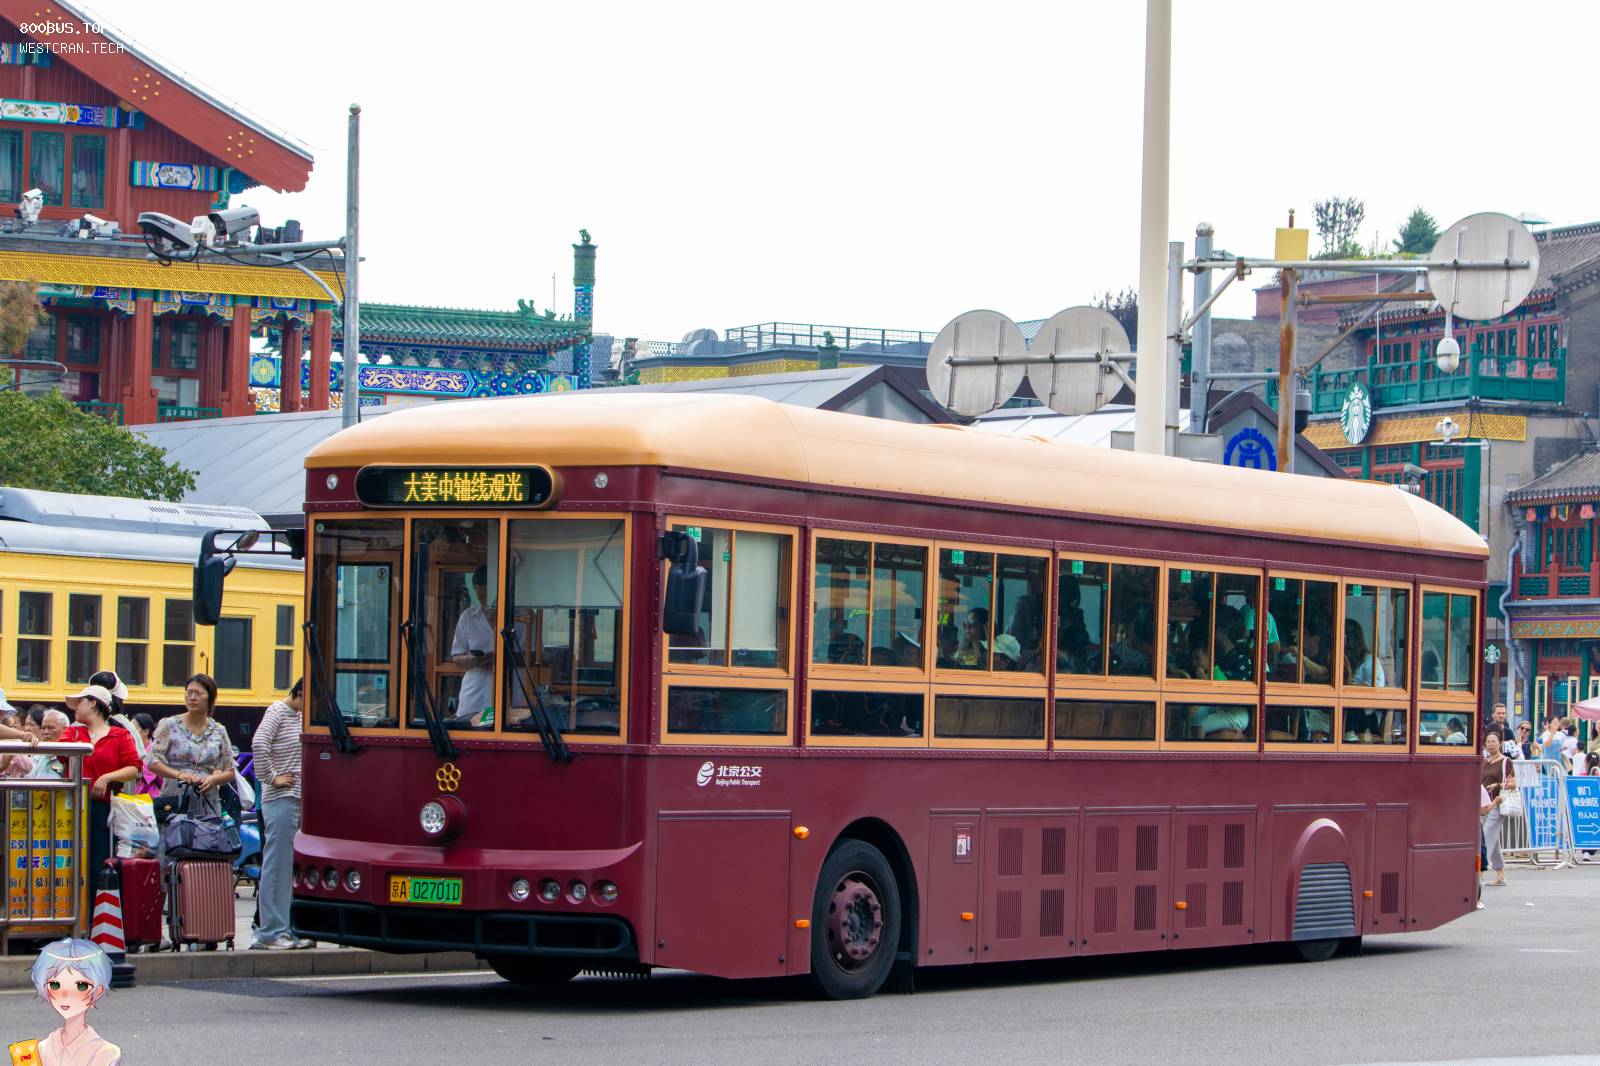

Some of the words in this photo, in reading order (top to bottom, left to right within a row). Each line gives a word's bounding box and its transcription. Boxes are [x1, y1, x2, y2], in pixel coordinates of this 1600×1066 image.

[404, 472, 523, 502] 大美中轴线观光
[717, 765, 763, 777] 北京公交
